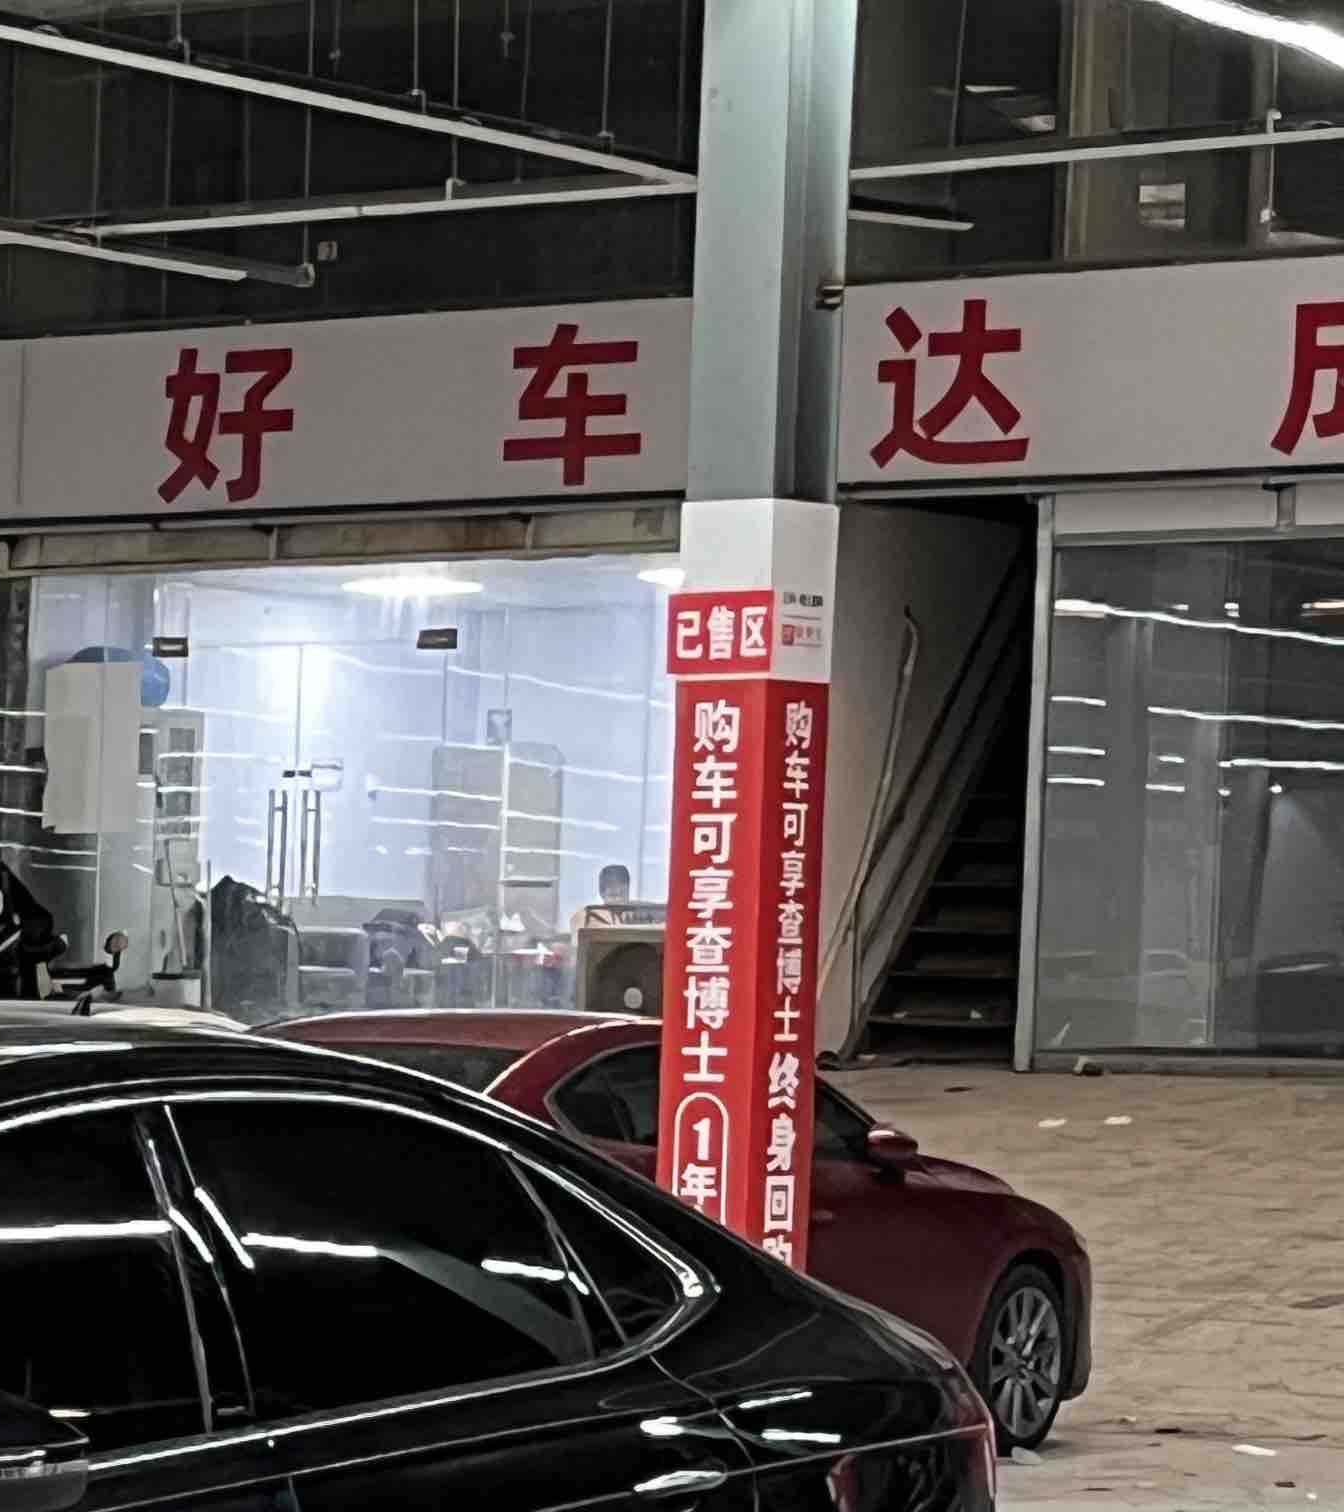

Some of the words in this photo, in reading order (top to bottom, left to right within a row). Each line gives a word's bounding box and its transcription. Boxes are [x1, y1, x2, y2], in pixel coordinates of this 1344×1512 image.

[676, 604, 767, 661] 已售区
[681, 699, 741, 1083] 购车可享查博士
[680, 1117, 718, 1214] 1年
